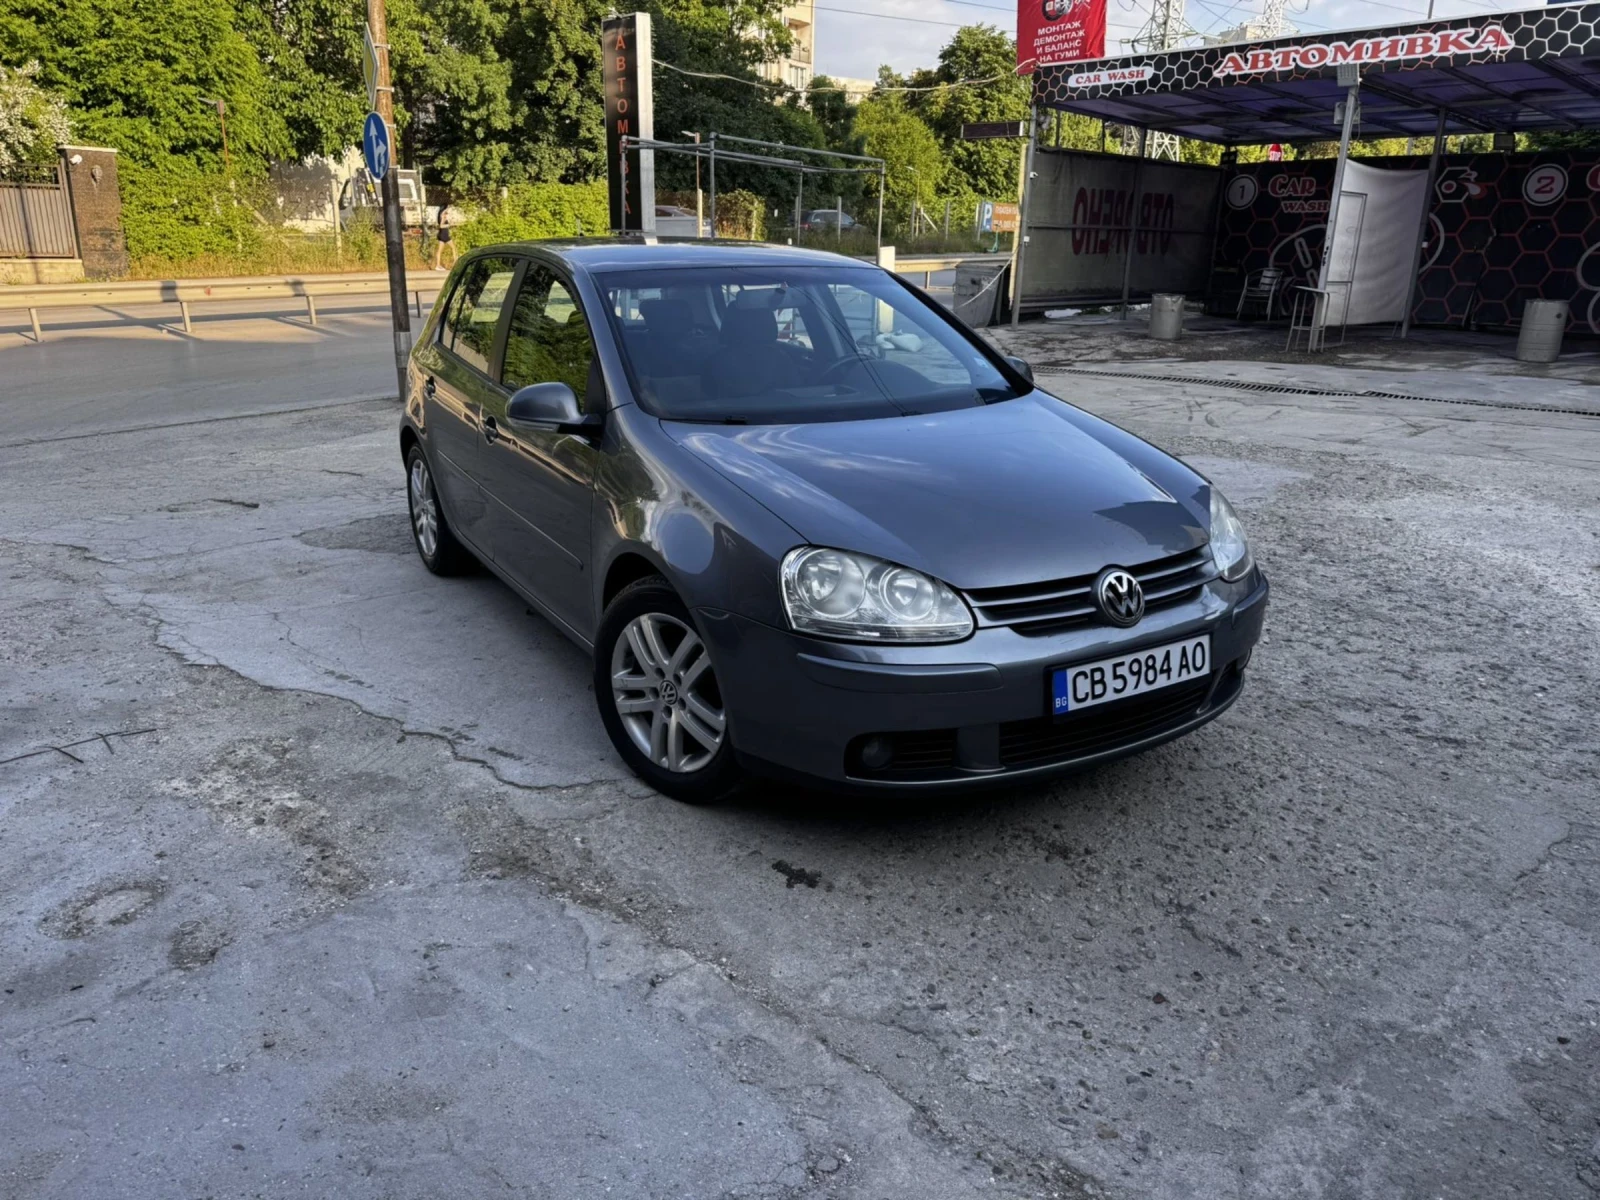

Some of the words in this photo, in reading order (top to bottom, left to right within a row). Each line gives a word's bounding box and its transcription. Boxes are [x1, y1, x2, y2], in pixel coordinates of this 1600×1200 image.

[1038, 20, 1082, 36] МОНТАЖ
[1033, 29, 1086, 47] ДЕМОНТАЖ
[1036, 46, 1043, 55] И
[1044, 39, 1082, 53] БАЛАНС
[1215, 26, 1514, 77] АВТОМИВКА
[1039, 54, 1053, 63] НА
[1054, 49, 1080, 61] ГУМИ
[1075, 74, 1102, 85] CAR
[1107, 69, 1146, 82] WASH
[1239, 185, 1247, 200] 1
[1268, 174, 1317, 198] CAR
[1534, 175, 1556, 195] 2
[1281, 200, 1330, 214] WASH
[1072, 666, 1107, 704] CB
[1112, 649, 1173, 694] 5984
[1177, 641, 1206, 678] AO
[1055, 697, 1068, 708] BG
